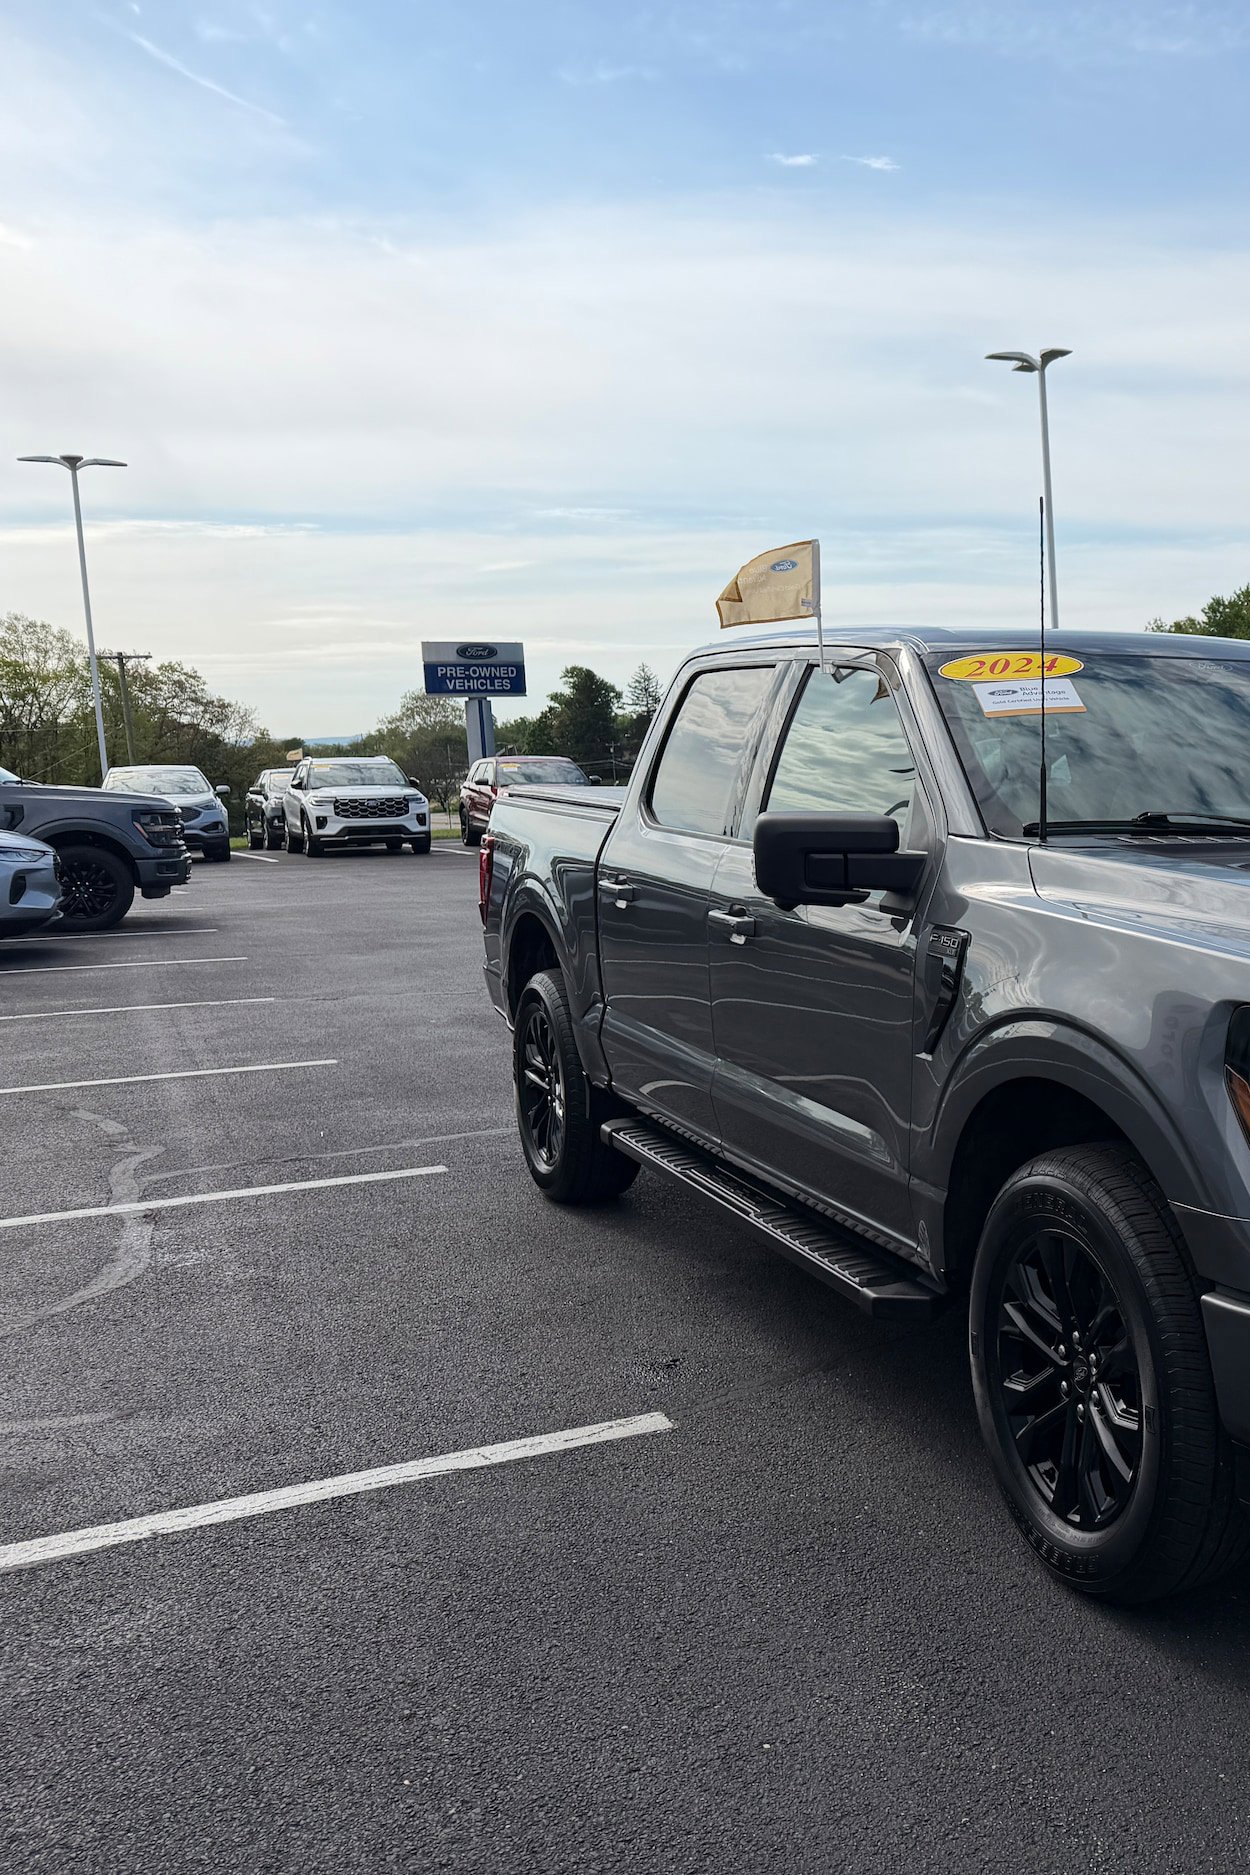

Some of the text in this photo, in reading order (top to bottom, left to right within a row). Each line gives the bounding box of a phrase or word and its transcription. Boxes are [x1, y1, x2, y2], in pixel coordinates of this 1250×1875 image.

[465, 647, 489, 656] Ford
[437, 666, 517, 678] PRE-OWNED
[964, 657, 1059, 678] 2024
[446, 679, 511, 690] VEHICLES
[930, 933, 959, 948] F-150
